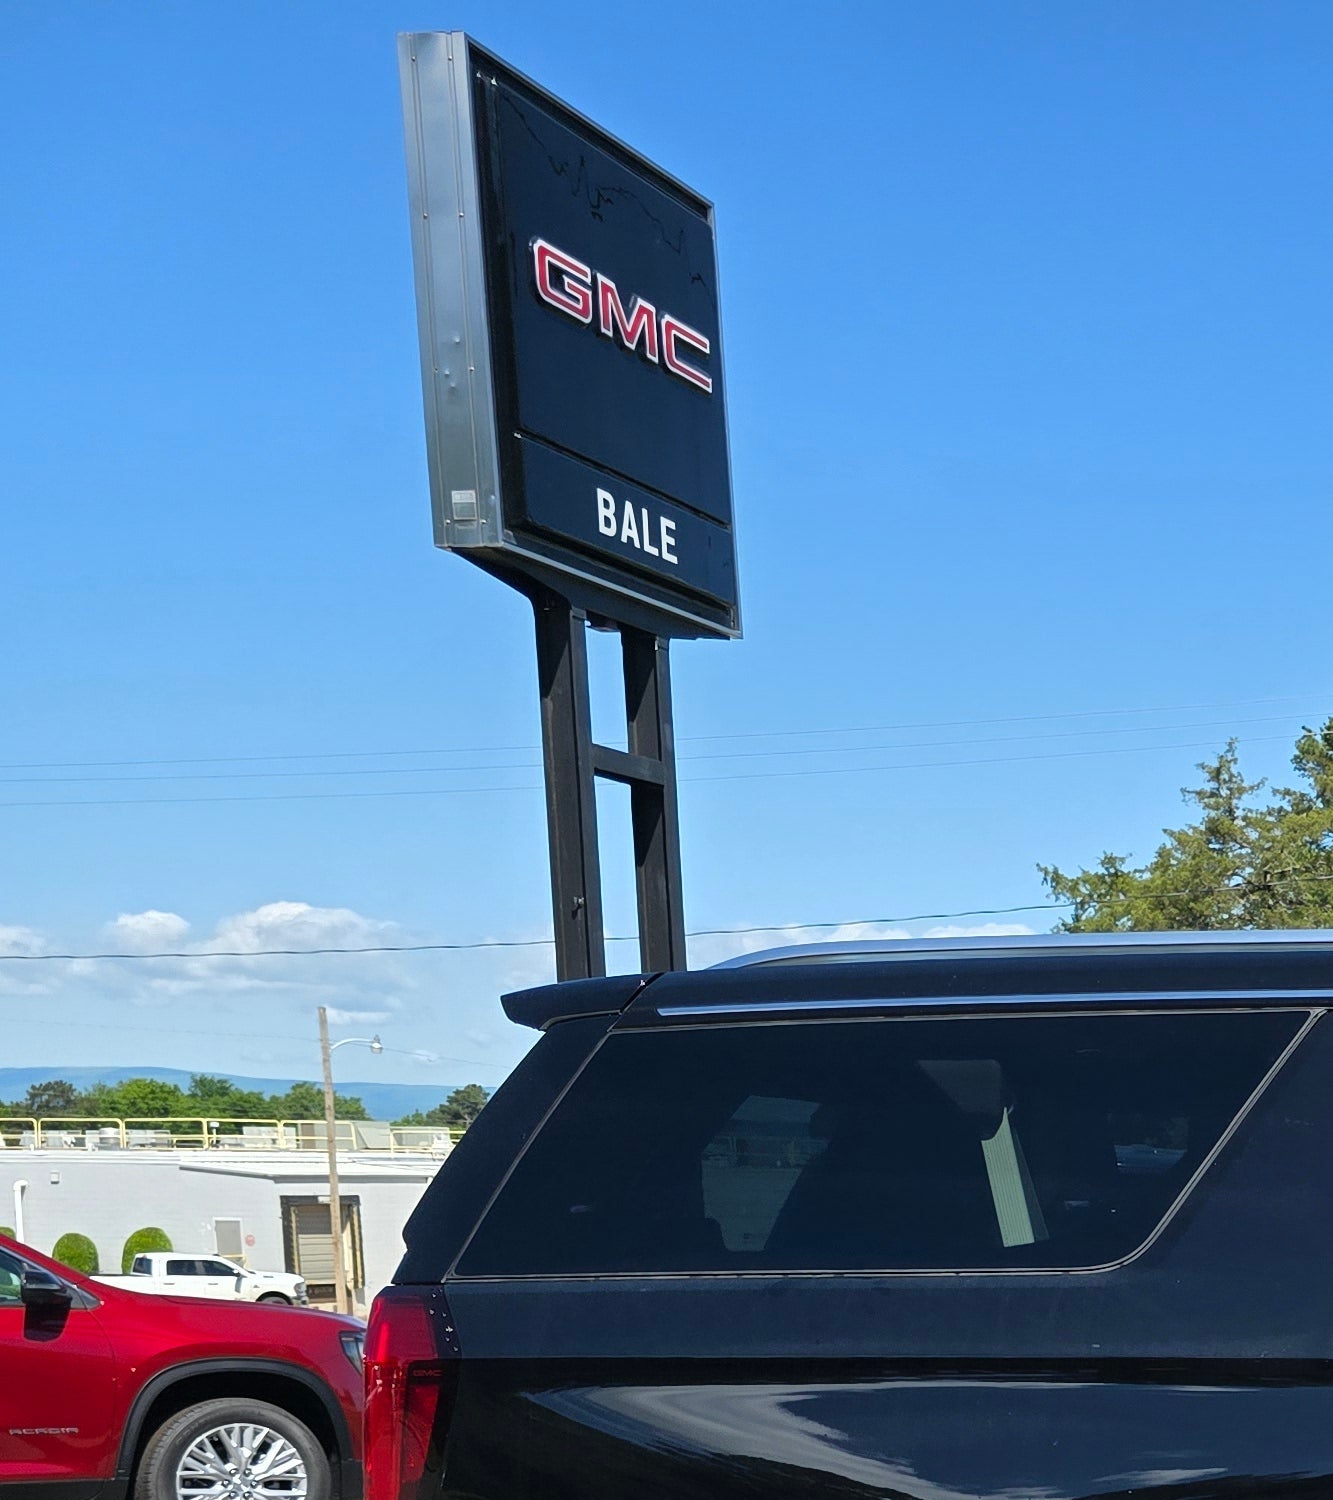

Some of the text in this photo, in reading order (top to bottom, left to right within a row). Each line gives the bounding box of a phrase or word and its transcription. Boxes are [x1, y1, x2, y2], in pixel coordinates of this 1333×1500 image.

[532, 238, 713, 393] GMC
[596, 488, 679, 565] BALE
[412, 1369, 442, 1377] GMC
[9, 1428, 79, 1437] ACADIA
